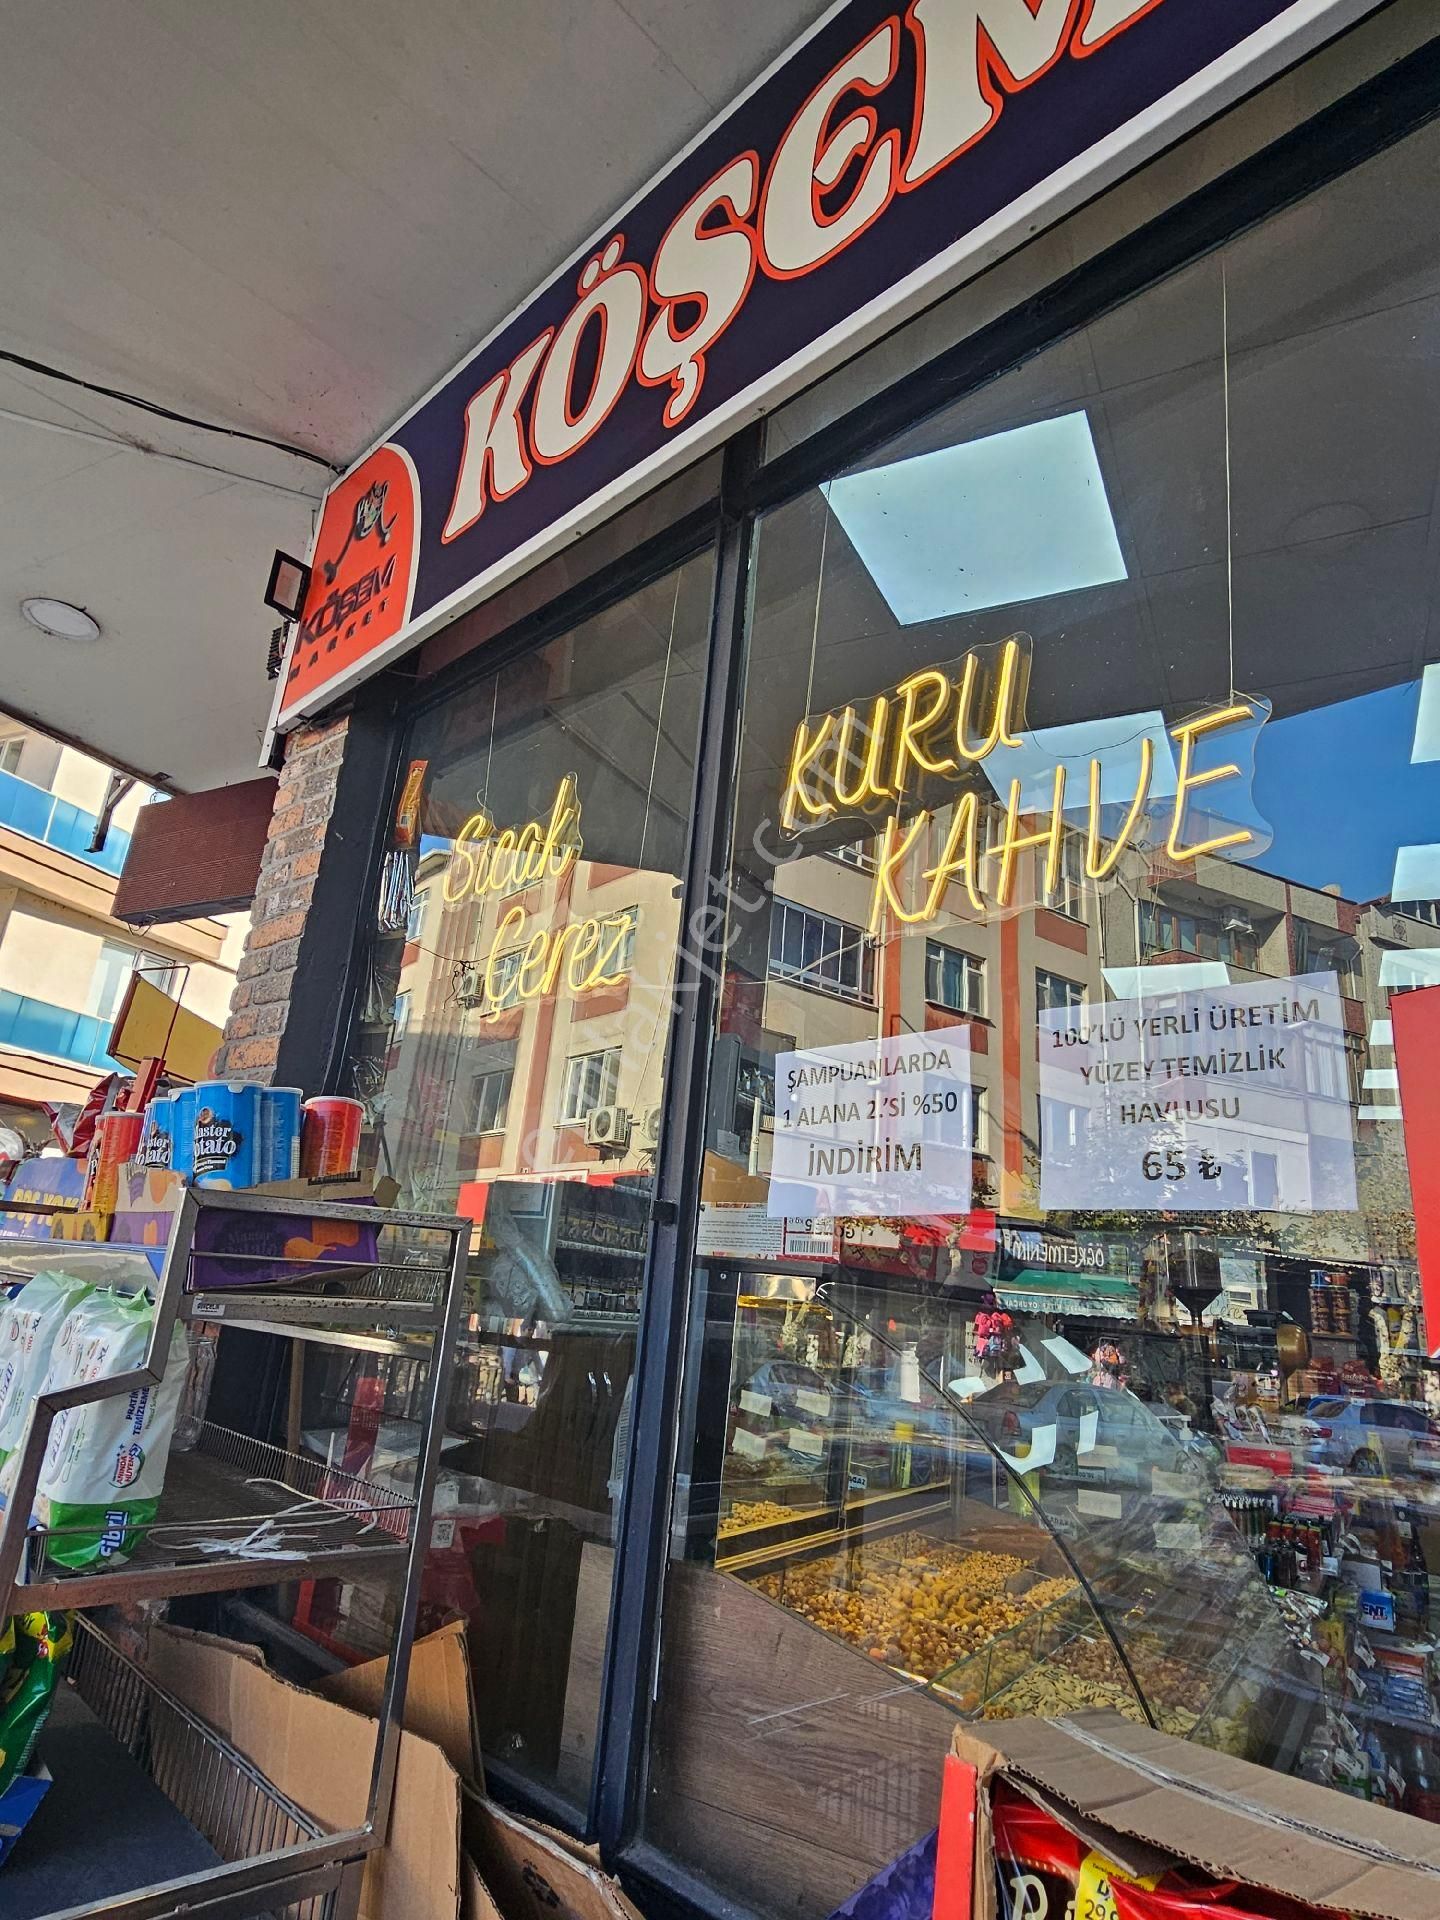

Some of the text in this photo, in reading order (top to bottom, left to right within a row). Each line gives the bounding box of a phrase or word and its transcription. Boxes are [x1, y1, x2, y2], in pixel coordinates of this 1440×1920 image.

[300, 552, 397, 645] KÖŞEM
[781, 639, 1023, 830] KURU
[868, 704, 1254, 937] KAHVE
[484, 905, 632, 1024] Çerez
[1134, 1007, 1200, 1037] YERLİ
[1209, 996, 1320, 1032] ÜRETİM
[787, 1048, 952, 1093] ŞAMPUANLARDA
[1079, 1044, 1287, 1086] YÜZEY TEMİZLİK
[783, 1109, 793, 1128] 1
[797, 1102, 861, 1127] ALANA
[913, 1091, 958, 1116] %50
[1120, 1097, 1241, 1125] HAVLUSU
[194, 1137, 237, 1158] otato
[807, 1136, 922, 1177] İNDİRİM
[1141, 1150, 1187, 1181] 65
